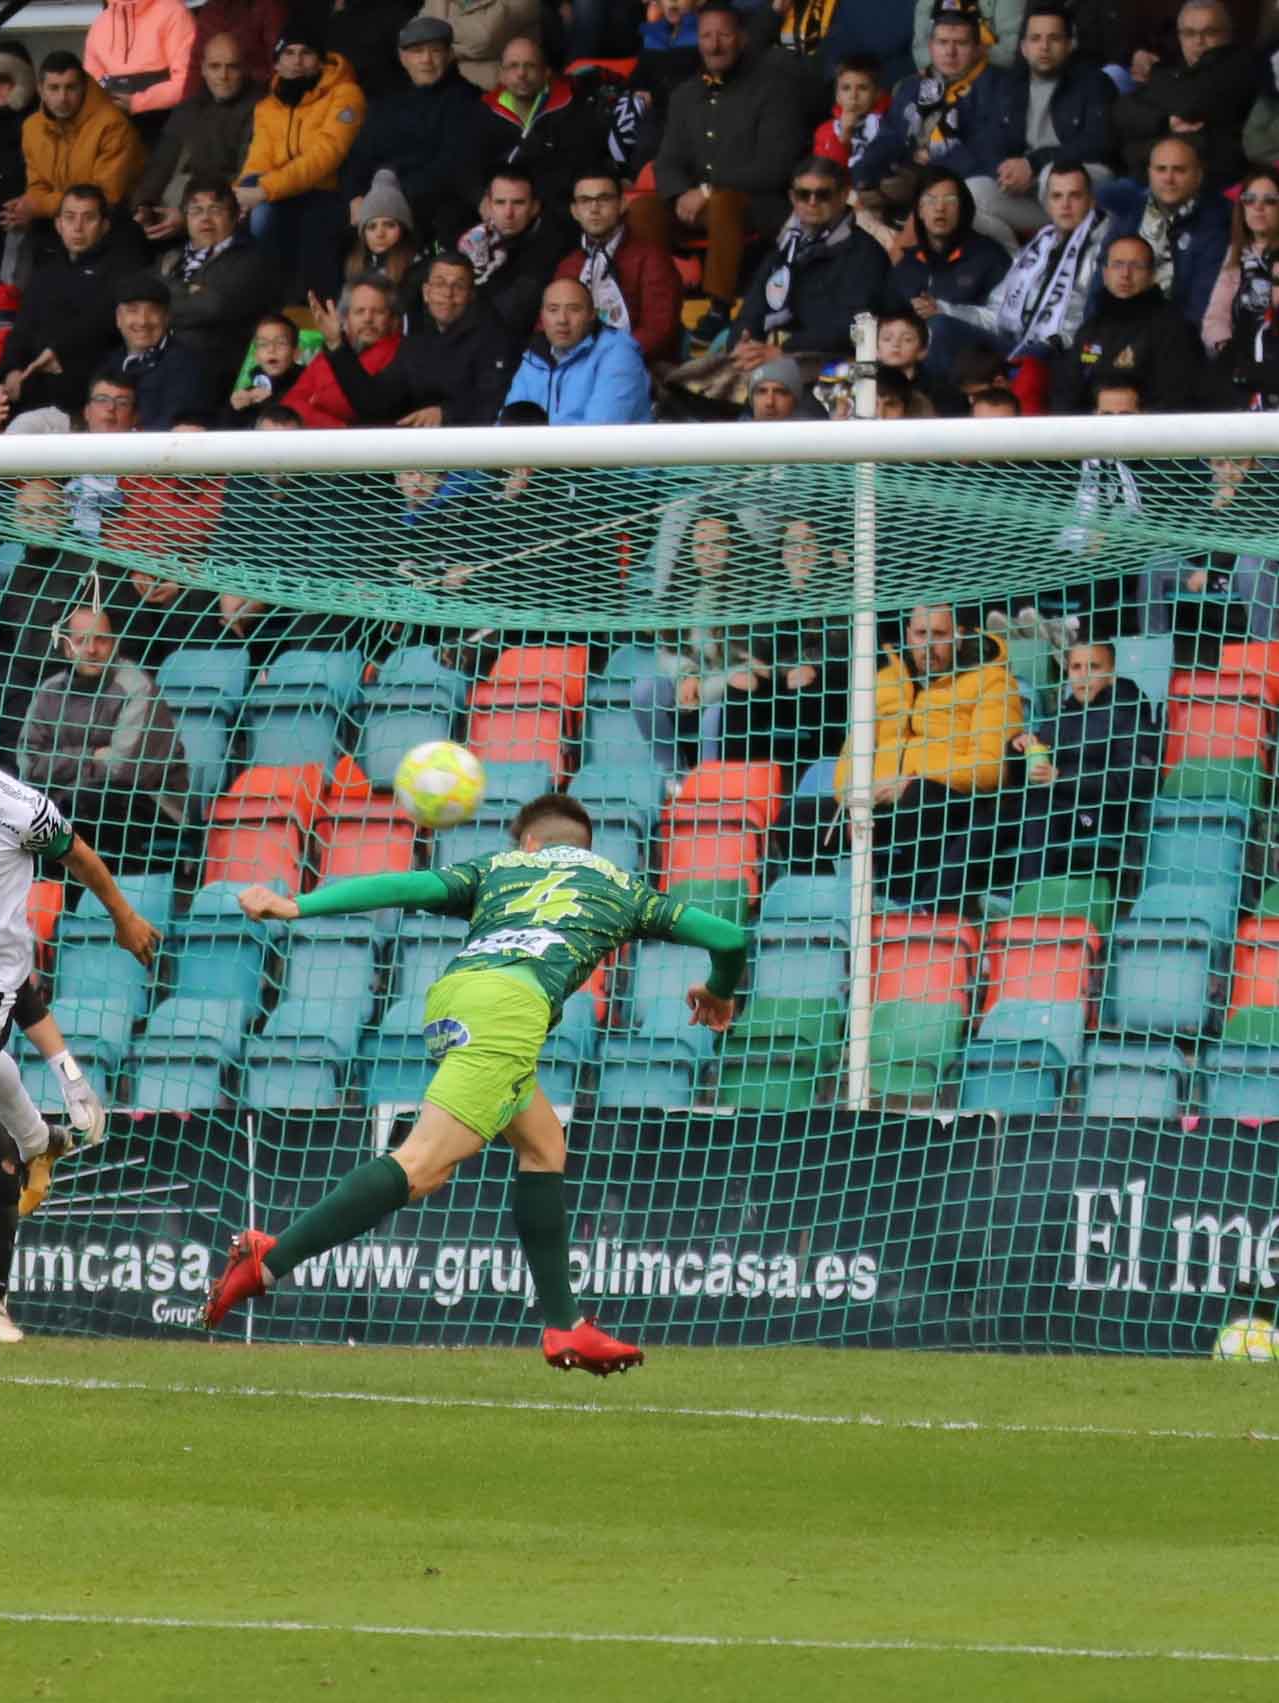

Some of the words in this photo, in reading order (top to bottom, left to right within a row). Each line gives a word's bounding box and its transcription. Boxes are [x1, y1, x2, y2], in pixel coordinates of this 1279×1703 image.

[504, 871, 583, 925] 4
[1068, 1179, 1148, 1292] El
[151, 1298, 206, 1327] Grup
